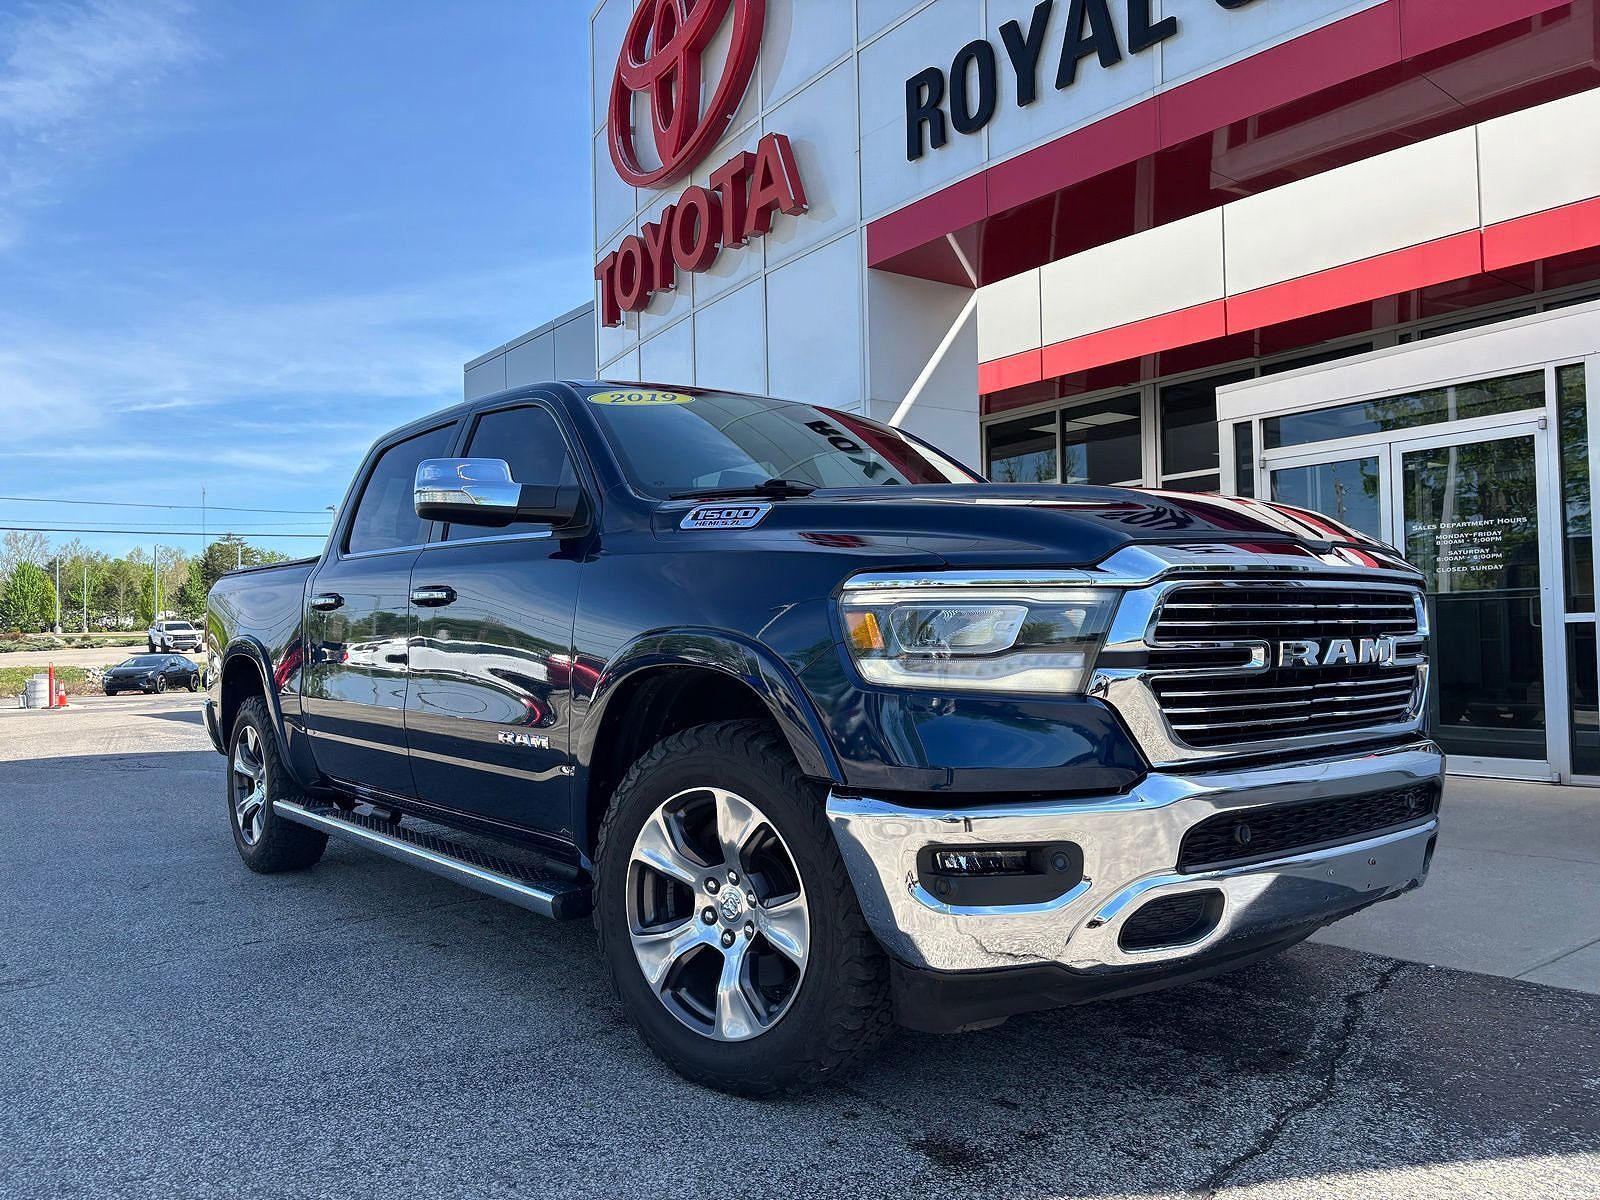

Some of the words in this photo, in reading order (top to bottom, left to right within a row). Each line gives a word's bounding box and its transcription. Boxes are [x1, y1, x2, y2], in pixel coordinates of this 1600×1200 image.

[905, 0, 1178, 162] ROYAL
[595, 132, 809, 328] TOYOTA
[610, 393, 677, 403] 2019
[697, 509, 757, 520] 1500
[1435, 530, 1502, 540] MONDAY-FRIDAY
[1447, 548, 1490, 556] SATURDAY
[1278, 638, 1392, 668] RAM
[498, 731, 550, 750] RAM
